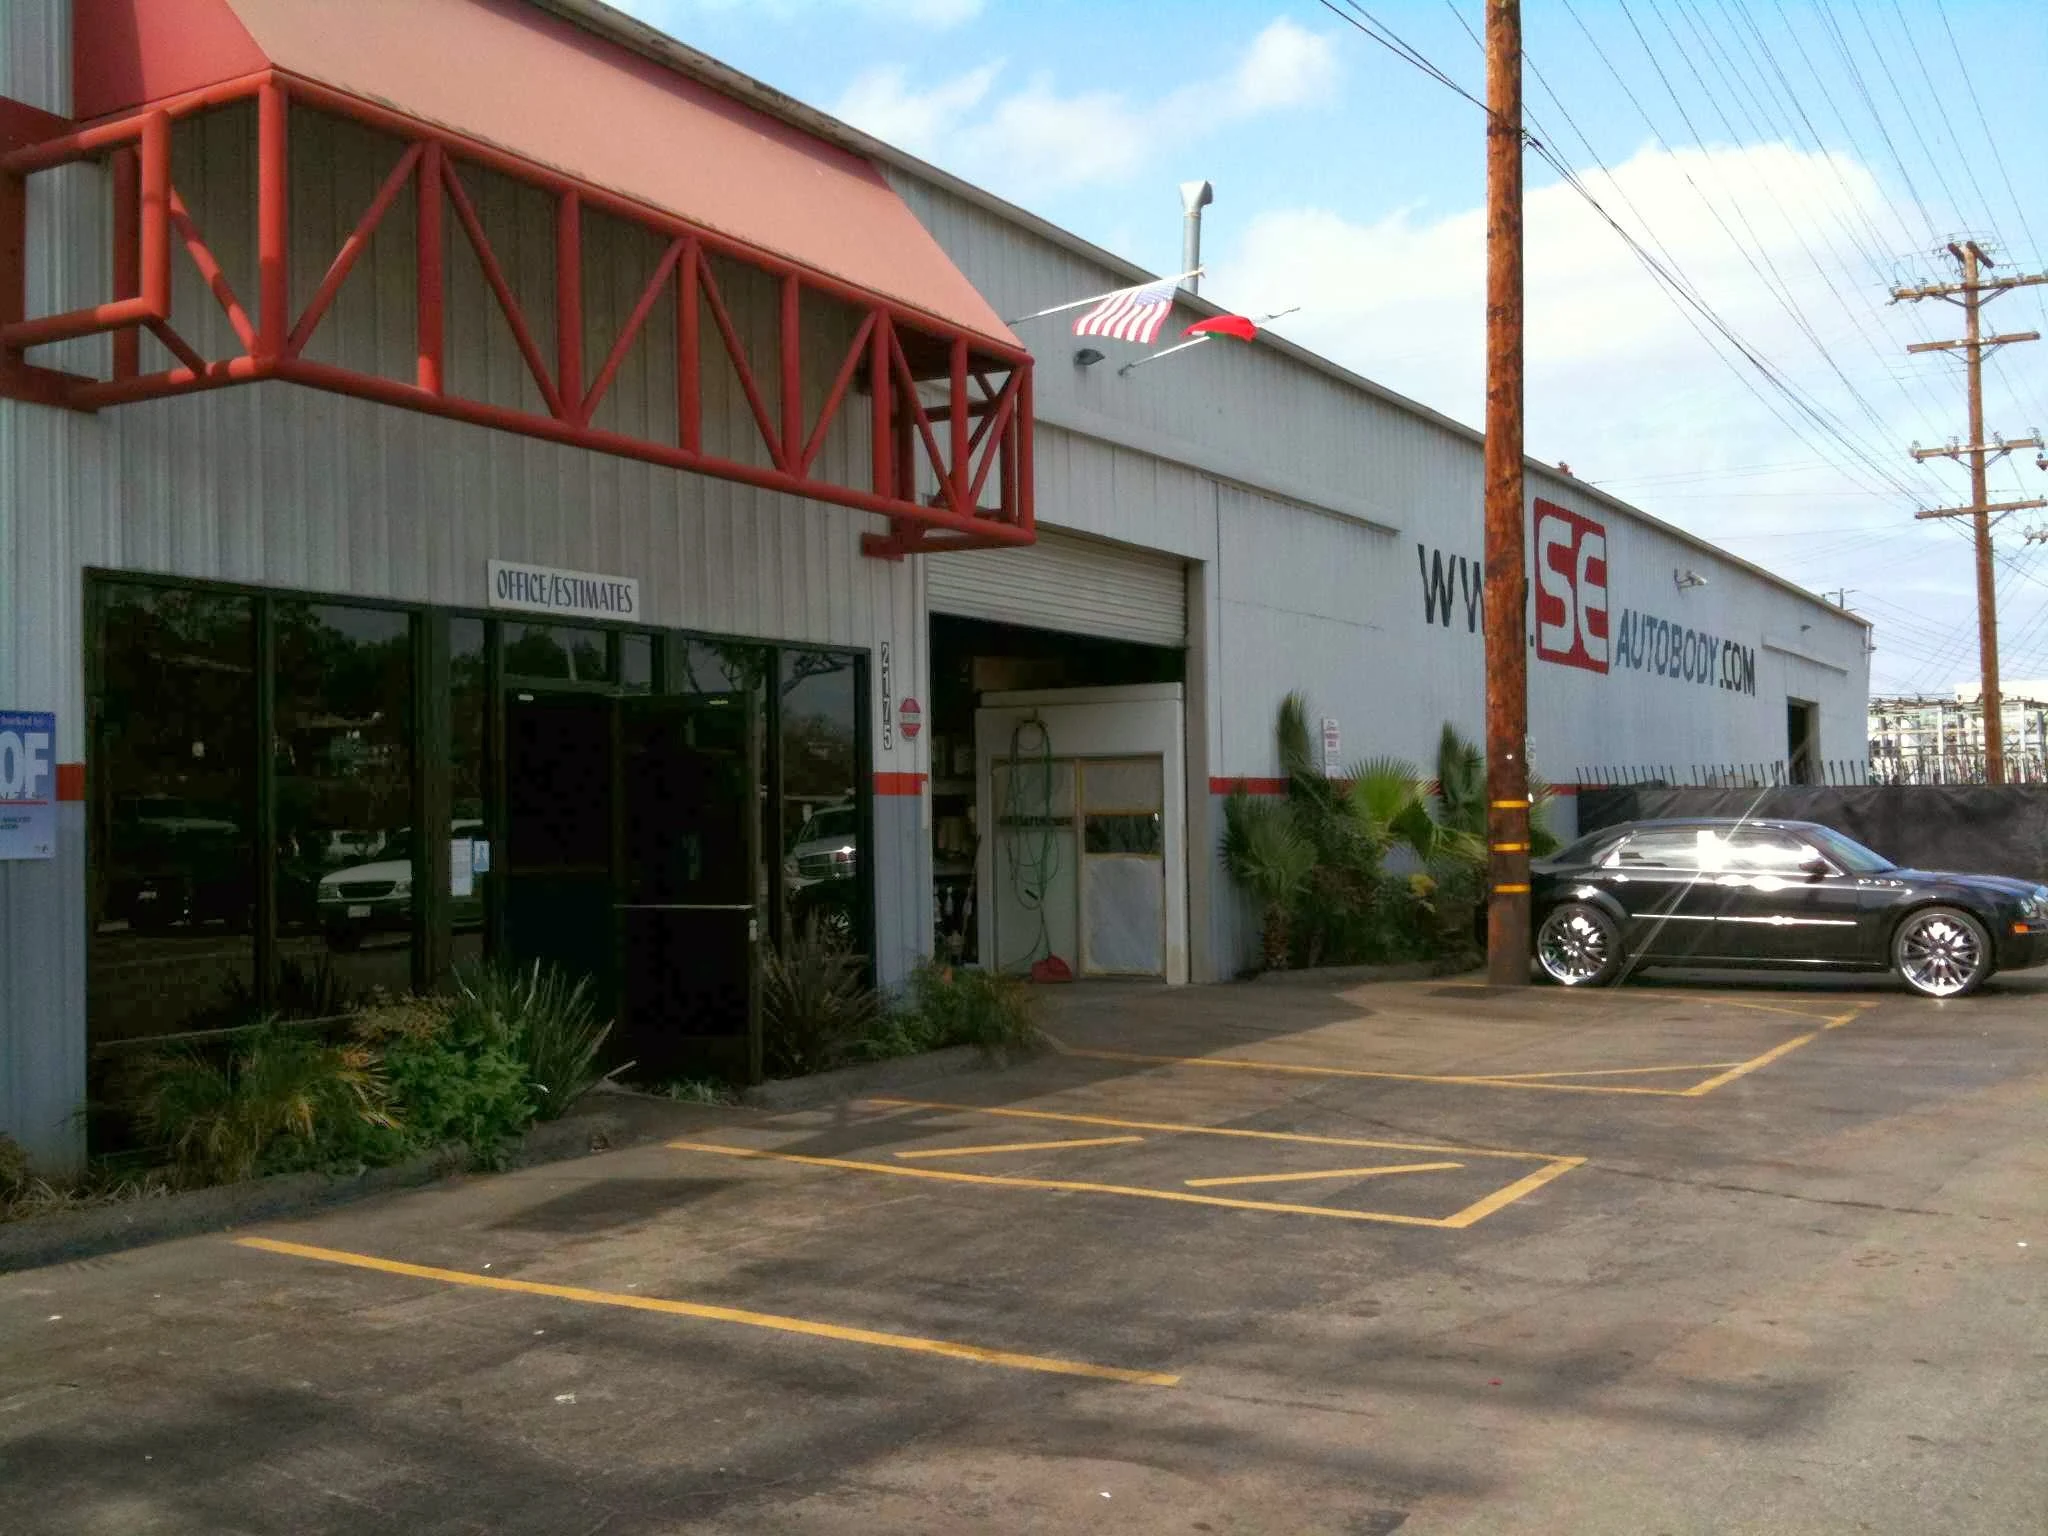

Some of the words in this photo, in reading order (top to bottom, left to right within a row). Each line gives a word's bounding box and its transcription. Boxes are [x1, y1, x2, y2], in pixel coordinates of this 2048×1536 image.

[497, 569, 633, 613] OFFICE/ESTIMATES
[881, 641, 892, 750] 2175
[1614, 608, 1757, 697] AUTOBODY.COM
